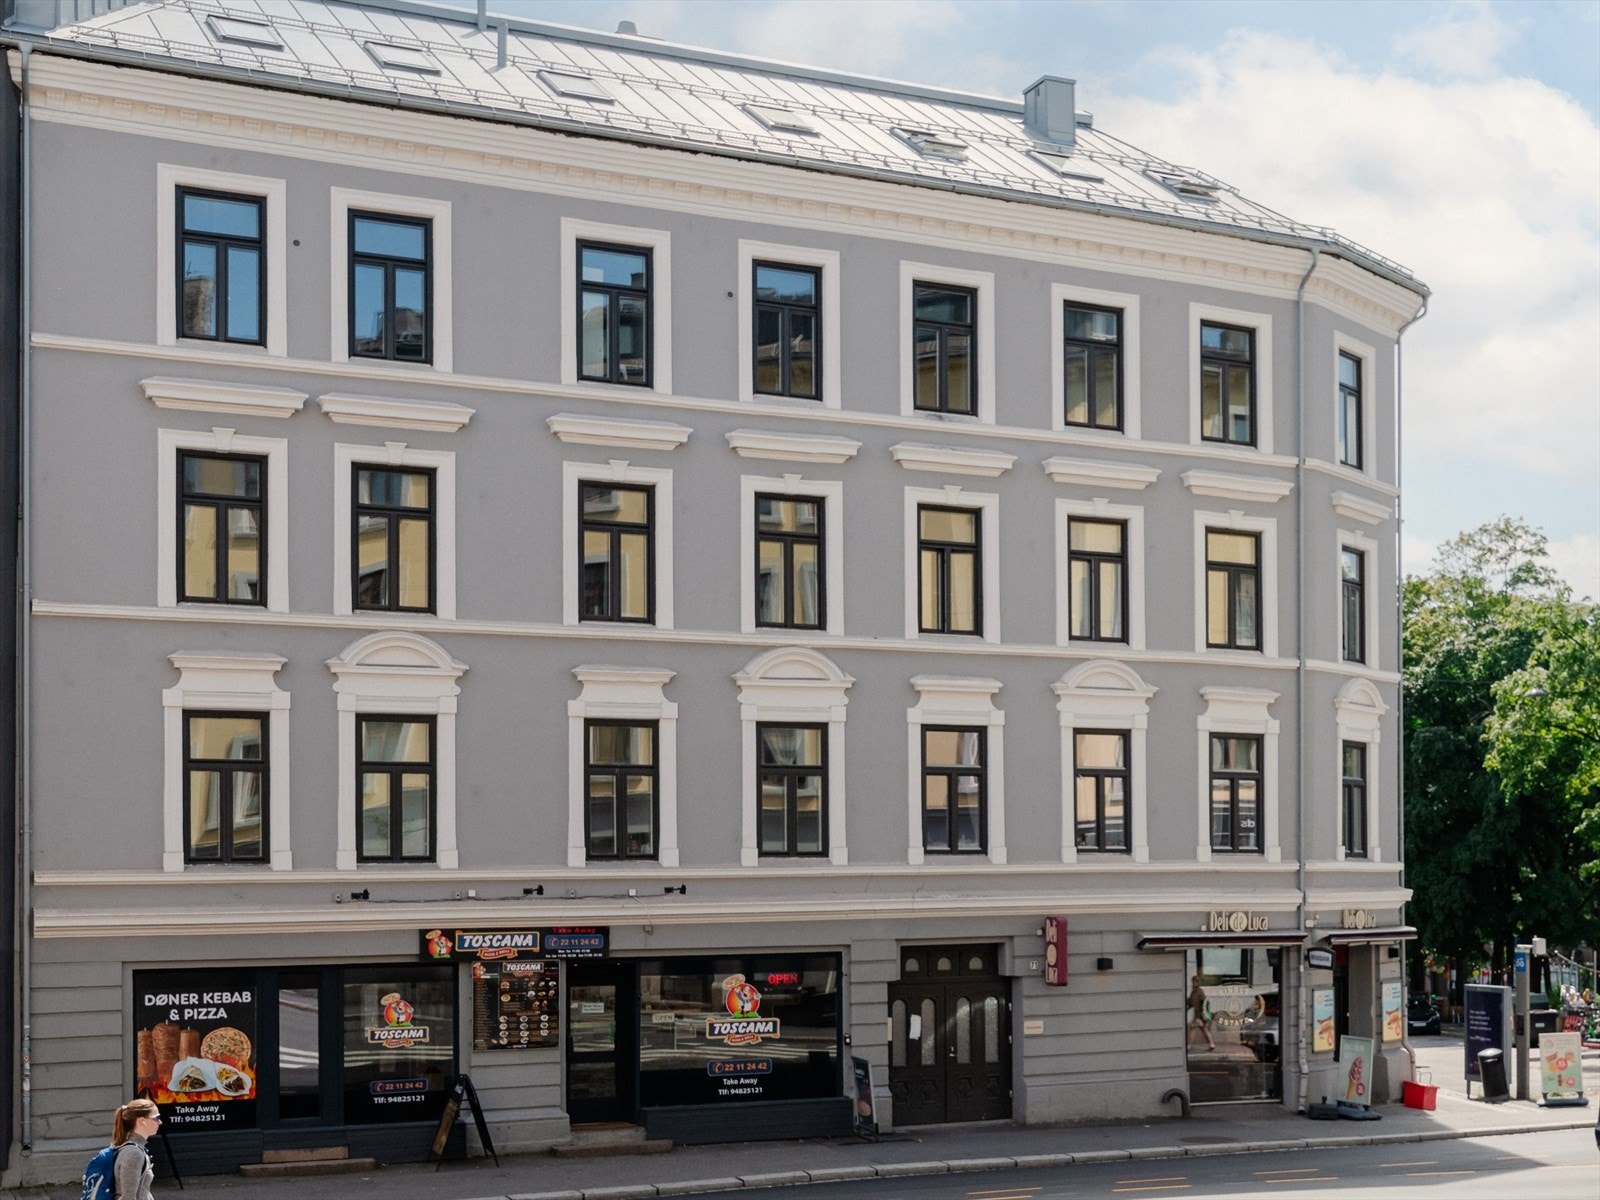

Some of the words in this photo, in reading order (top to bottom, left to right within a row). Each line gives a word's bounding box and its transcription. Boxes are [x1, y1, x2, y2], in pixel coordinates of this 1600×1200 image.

[1210, 911, 1228, 931] Deli
[1249, 910, 1268, 930] Luca
[464, 934, 533, 948] TOSCANA
[768, 974, 798, 984] OPEN
[144, 994, 198, 1006] DØNER
[203, 992, 252, 1004] KEBAB
[170, 1009, 180, 1020] &
[184, 1008, 228, 1020] PIZZA
[714, 1022, 773, 1034] TOSCANA
[374, 1030, 424, 1039] TOSCANA
[197, 1105, 219, 1113] Away
